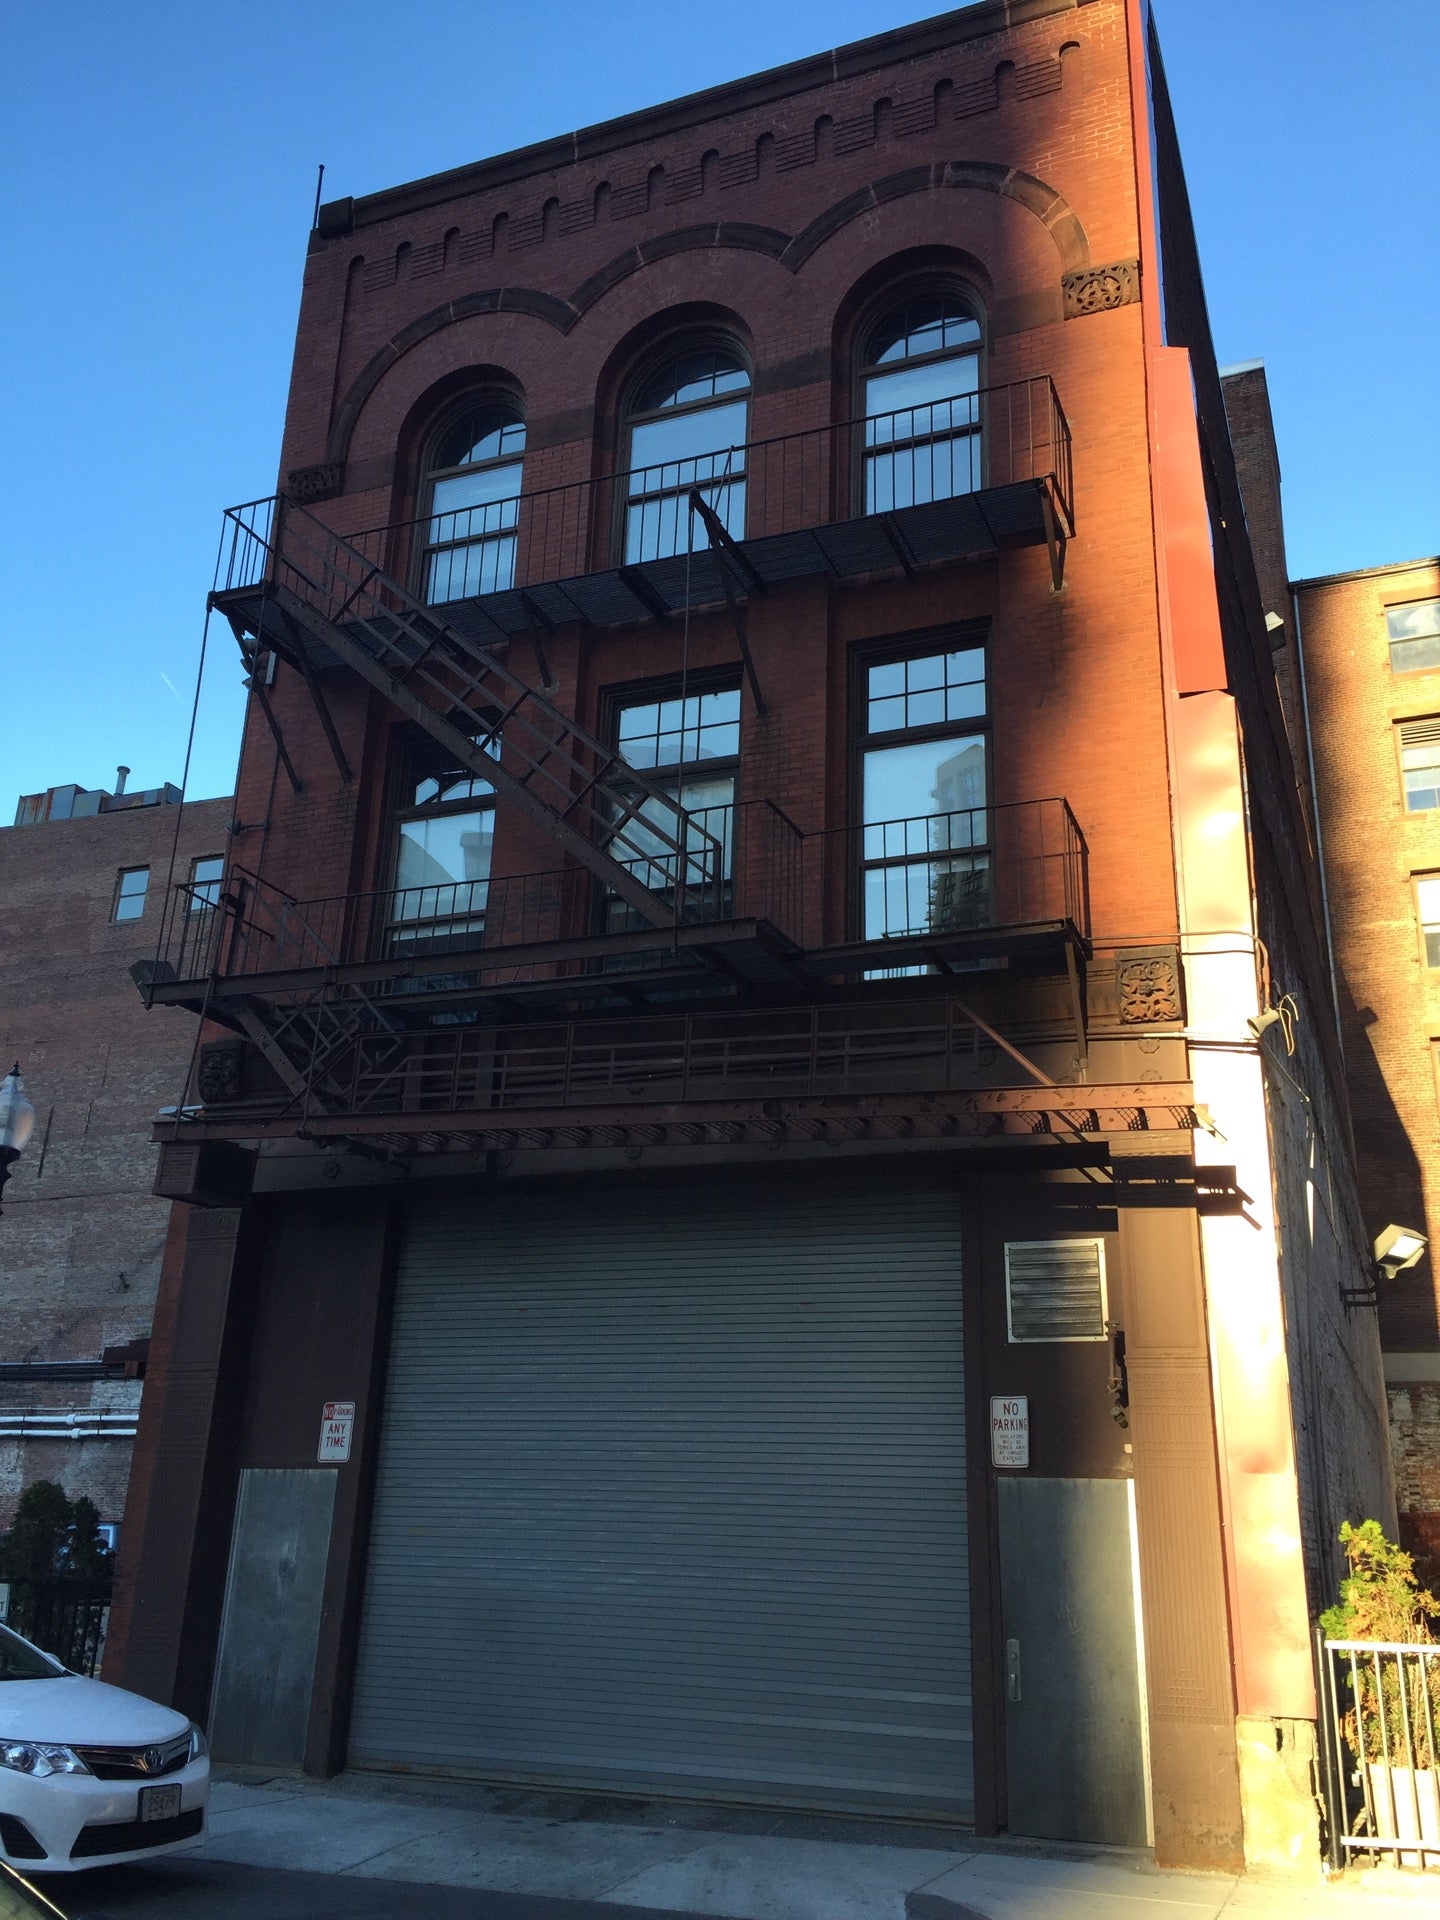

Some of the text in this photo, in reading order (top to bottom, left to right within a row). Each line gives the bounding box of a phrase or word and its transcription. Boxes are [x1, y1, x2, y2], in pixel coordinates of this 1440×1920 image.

[324, 1406, 334, 1419] NO
[1003, 1402, 1019, 1416] NO
[328, 1423, 346, 1434] ANY
[993, 1418, 1028, 1431] PARKING
[326, 1436, 345, 1447] TIME
